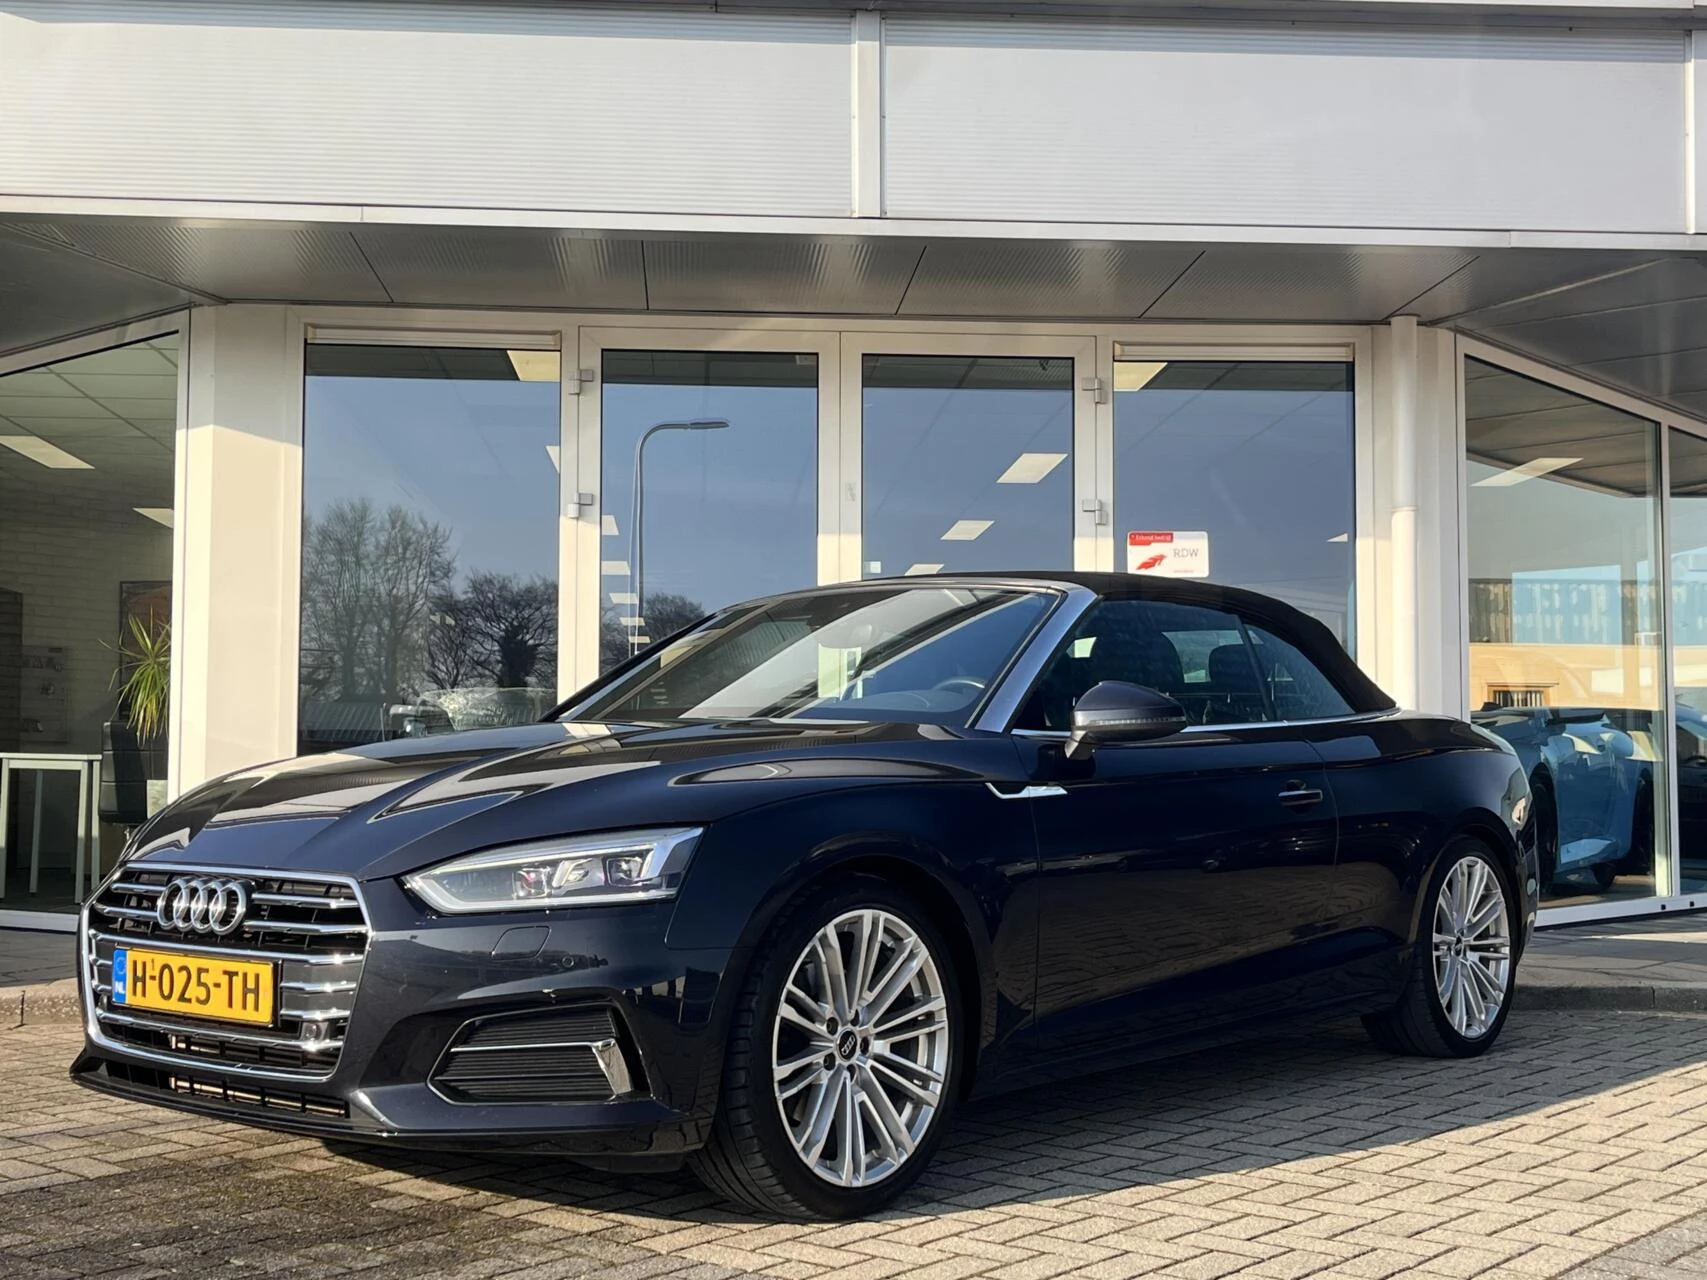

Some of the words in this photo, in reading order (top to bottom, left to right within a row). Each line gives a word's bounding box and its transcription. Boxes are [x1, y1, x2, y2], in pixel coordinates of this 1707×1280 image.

[1172, 547, 1199, 558] RDW
[115, 980, 126, 994] NL
[132, 959, 260, 1012] H-025-TH
